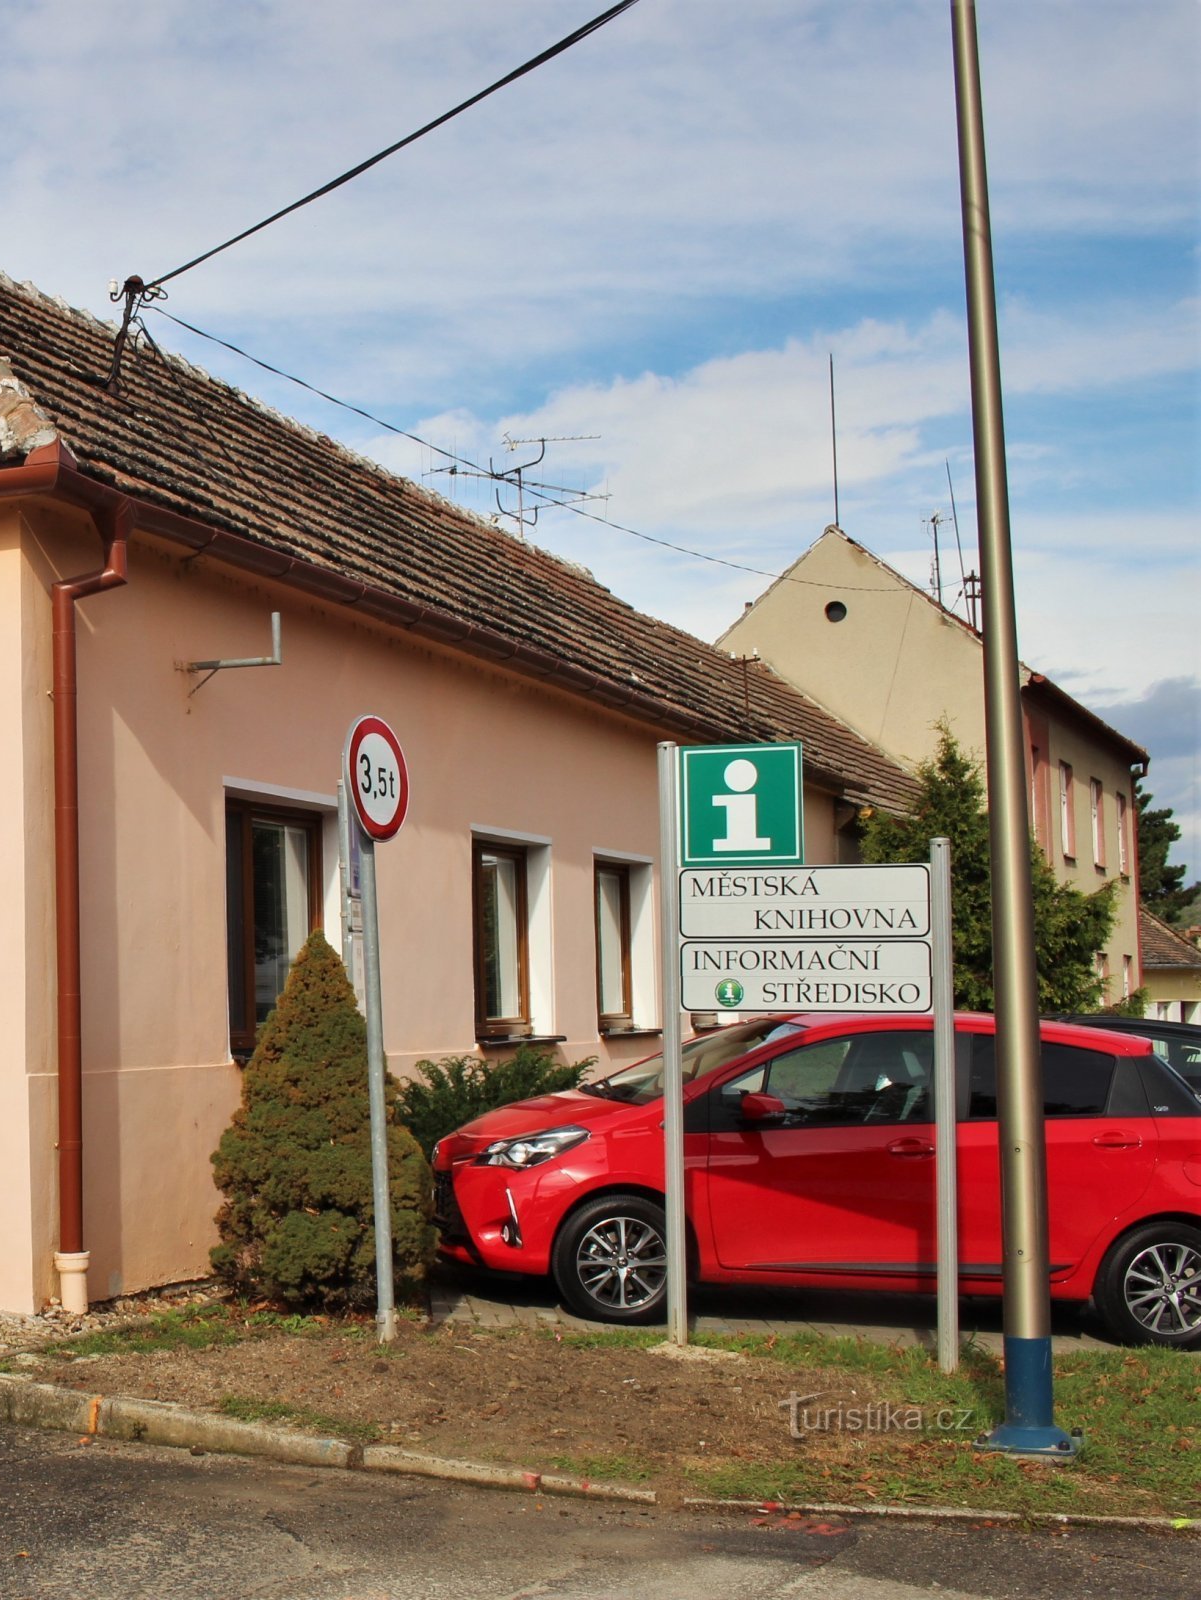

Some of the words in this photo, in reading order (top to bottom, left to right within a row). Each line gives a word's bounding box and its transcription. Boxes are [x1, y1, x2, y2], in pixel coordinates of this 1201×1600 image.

[690, 869, 821, 898] MĚSTSKÁ
[753, 908, 919, 931] KNIHOVNA
[691, 944, 883, 972] INFORMAČNÍ
[762, 978, 921, 1005] STŘEDISKO
